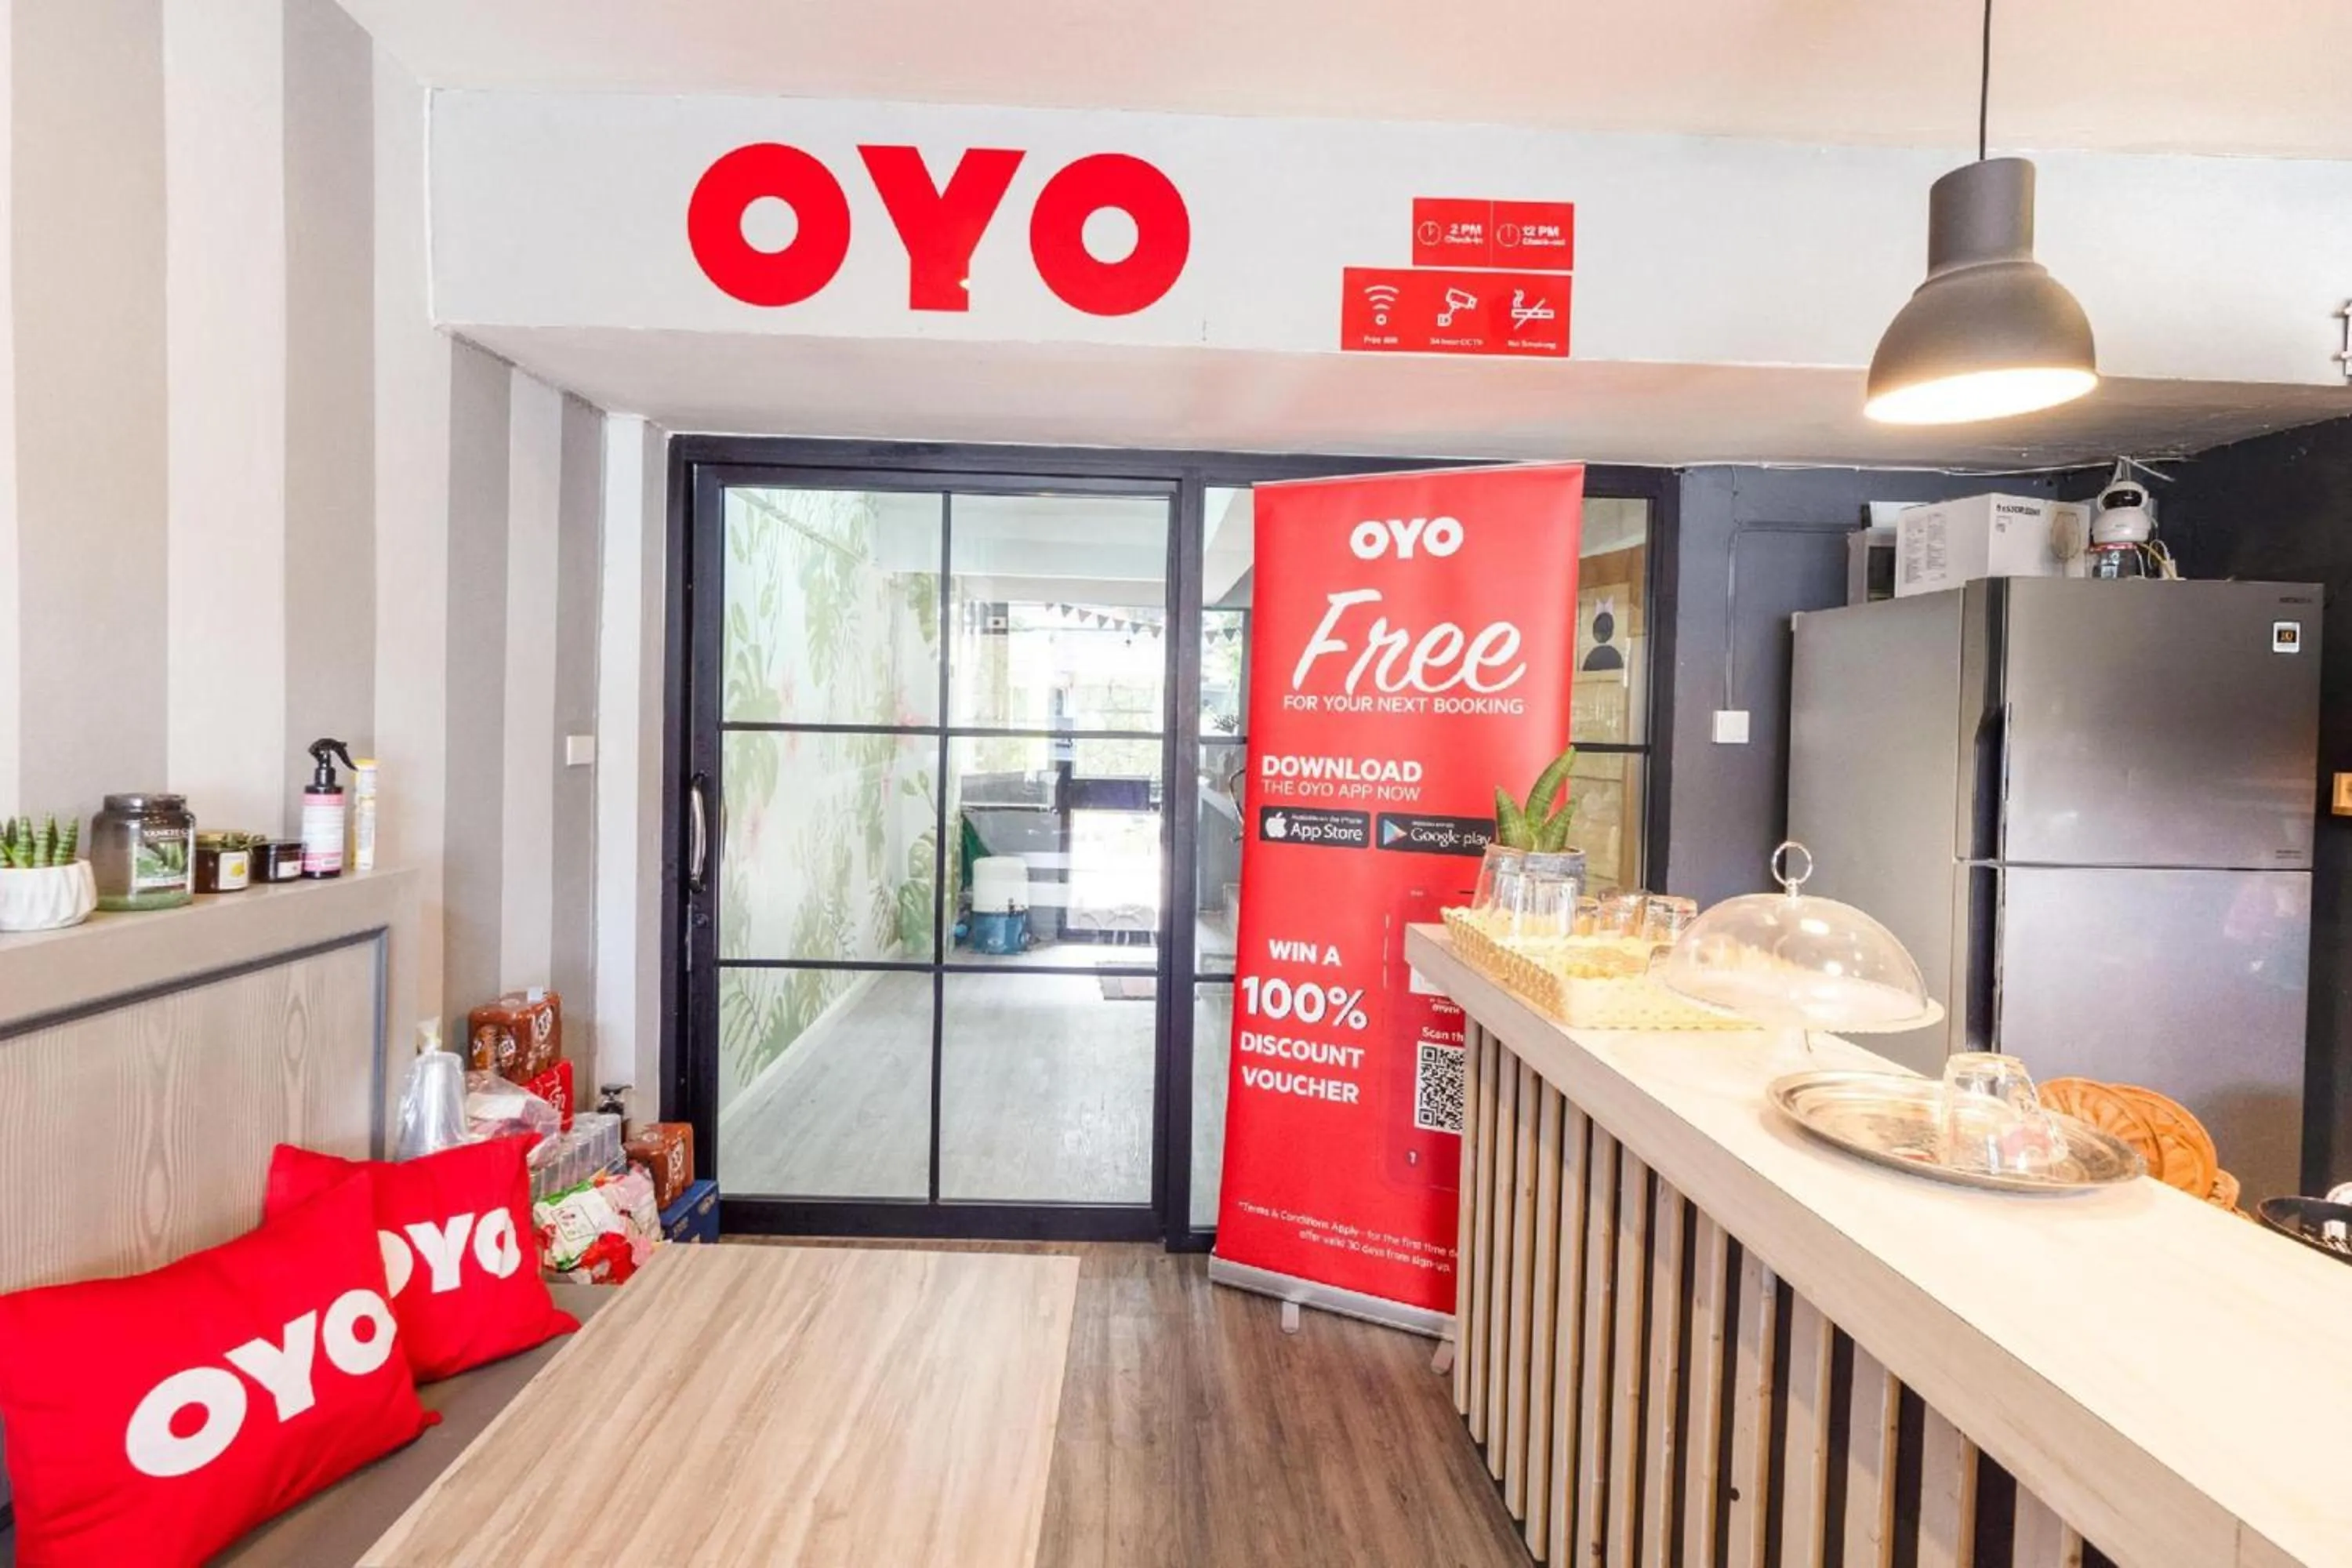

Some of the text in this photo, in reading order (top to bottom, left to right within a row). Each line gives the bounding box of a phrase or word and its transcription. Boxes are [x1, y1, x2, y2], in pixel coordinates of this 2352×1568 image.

[688, 142, 1190, 316] OYO
[1450, 223, 1482, 235] 2 PM
[1523, 226, 1559, 238] 12 PM
[1349, 516, 1464, 560] OYO
[1292, 588, 1527, 695] Free
[1283, 695, 1524, 714] FOR YOUR NEXT BOOKING
[1261, 754, 1423, 782] DOWNLOAD
[1261, 780, 1421, 801] THE OYO APP NOW
[1290, 822, 1363, 841] App Store
[1411, 827, 1491, 850] Google play
[1269, 938, 1342, 967] WIN A
[1241, 975, 1368, 1031] 100%
[1422, 1026, 1464, 1042] Scan th
[1240, 1031, 1364, 1069] DISCOUNT
[1242, 1065, 1359, 1105] VOUCHER
[1280, 1210, 1329, 1229] Conditions
[1331, 1221, 1359, 1236] Apply
[1367, 1229, 1381, 1241] for
[1383, 1233, 1399, 1245] the
[1402, 1236, 1422, 1250] first
[1424, 1242, 1446, 1255] time
[1348, 1240, 1360, 1250] 30
[1361, 1244, 1385, 1258] days
[1386, 1248, 1410, 1262] from
[126, 1289, 397, 1478] OYO
